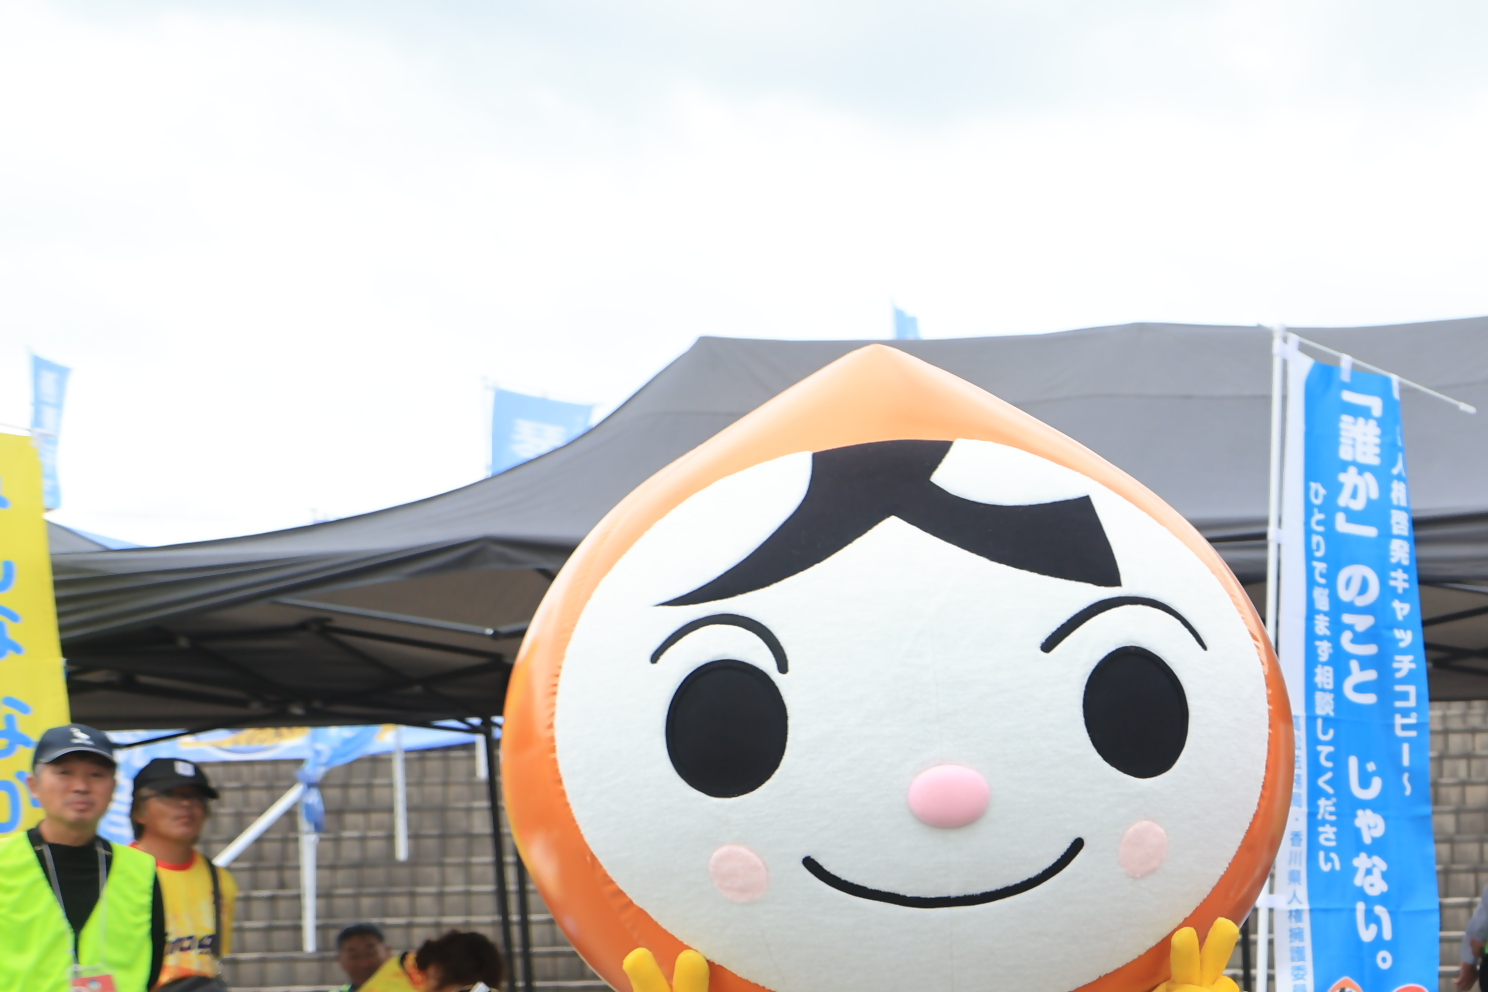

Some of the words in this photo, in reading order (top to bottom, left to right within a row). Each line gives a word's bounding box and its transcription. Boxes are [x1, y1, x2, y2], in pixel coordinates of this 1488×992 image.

[1335, 388, 1384, 706] 「誰か」のこと
[1348, 754, 1394, 970] じゃない。
